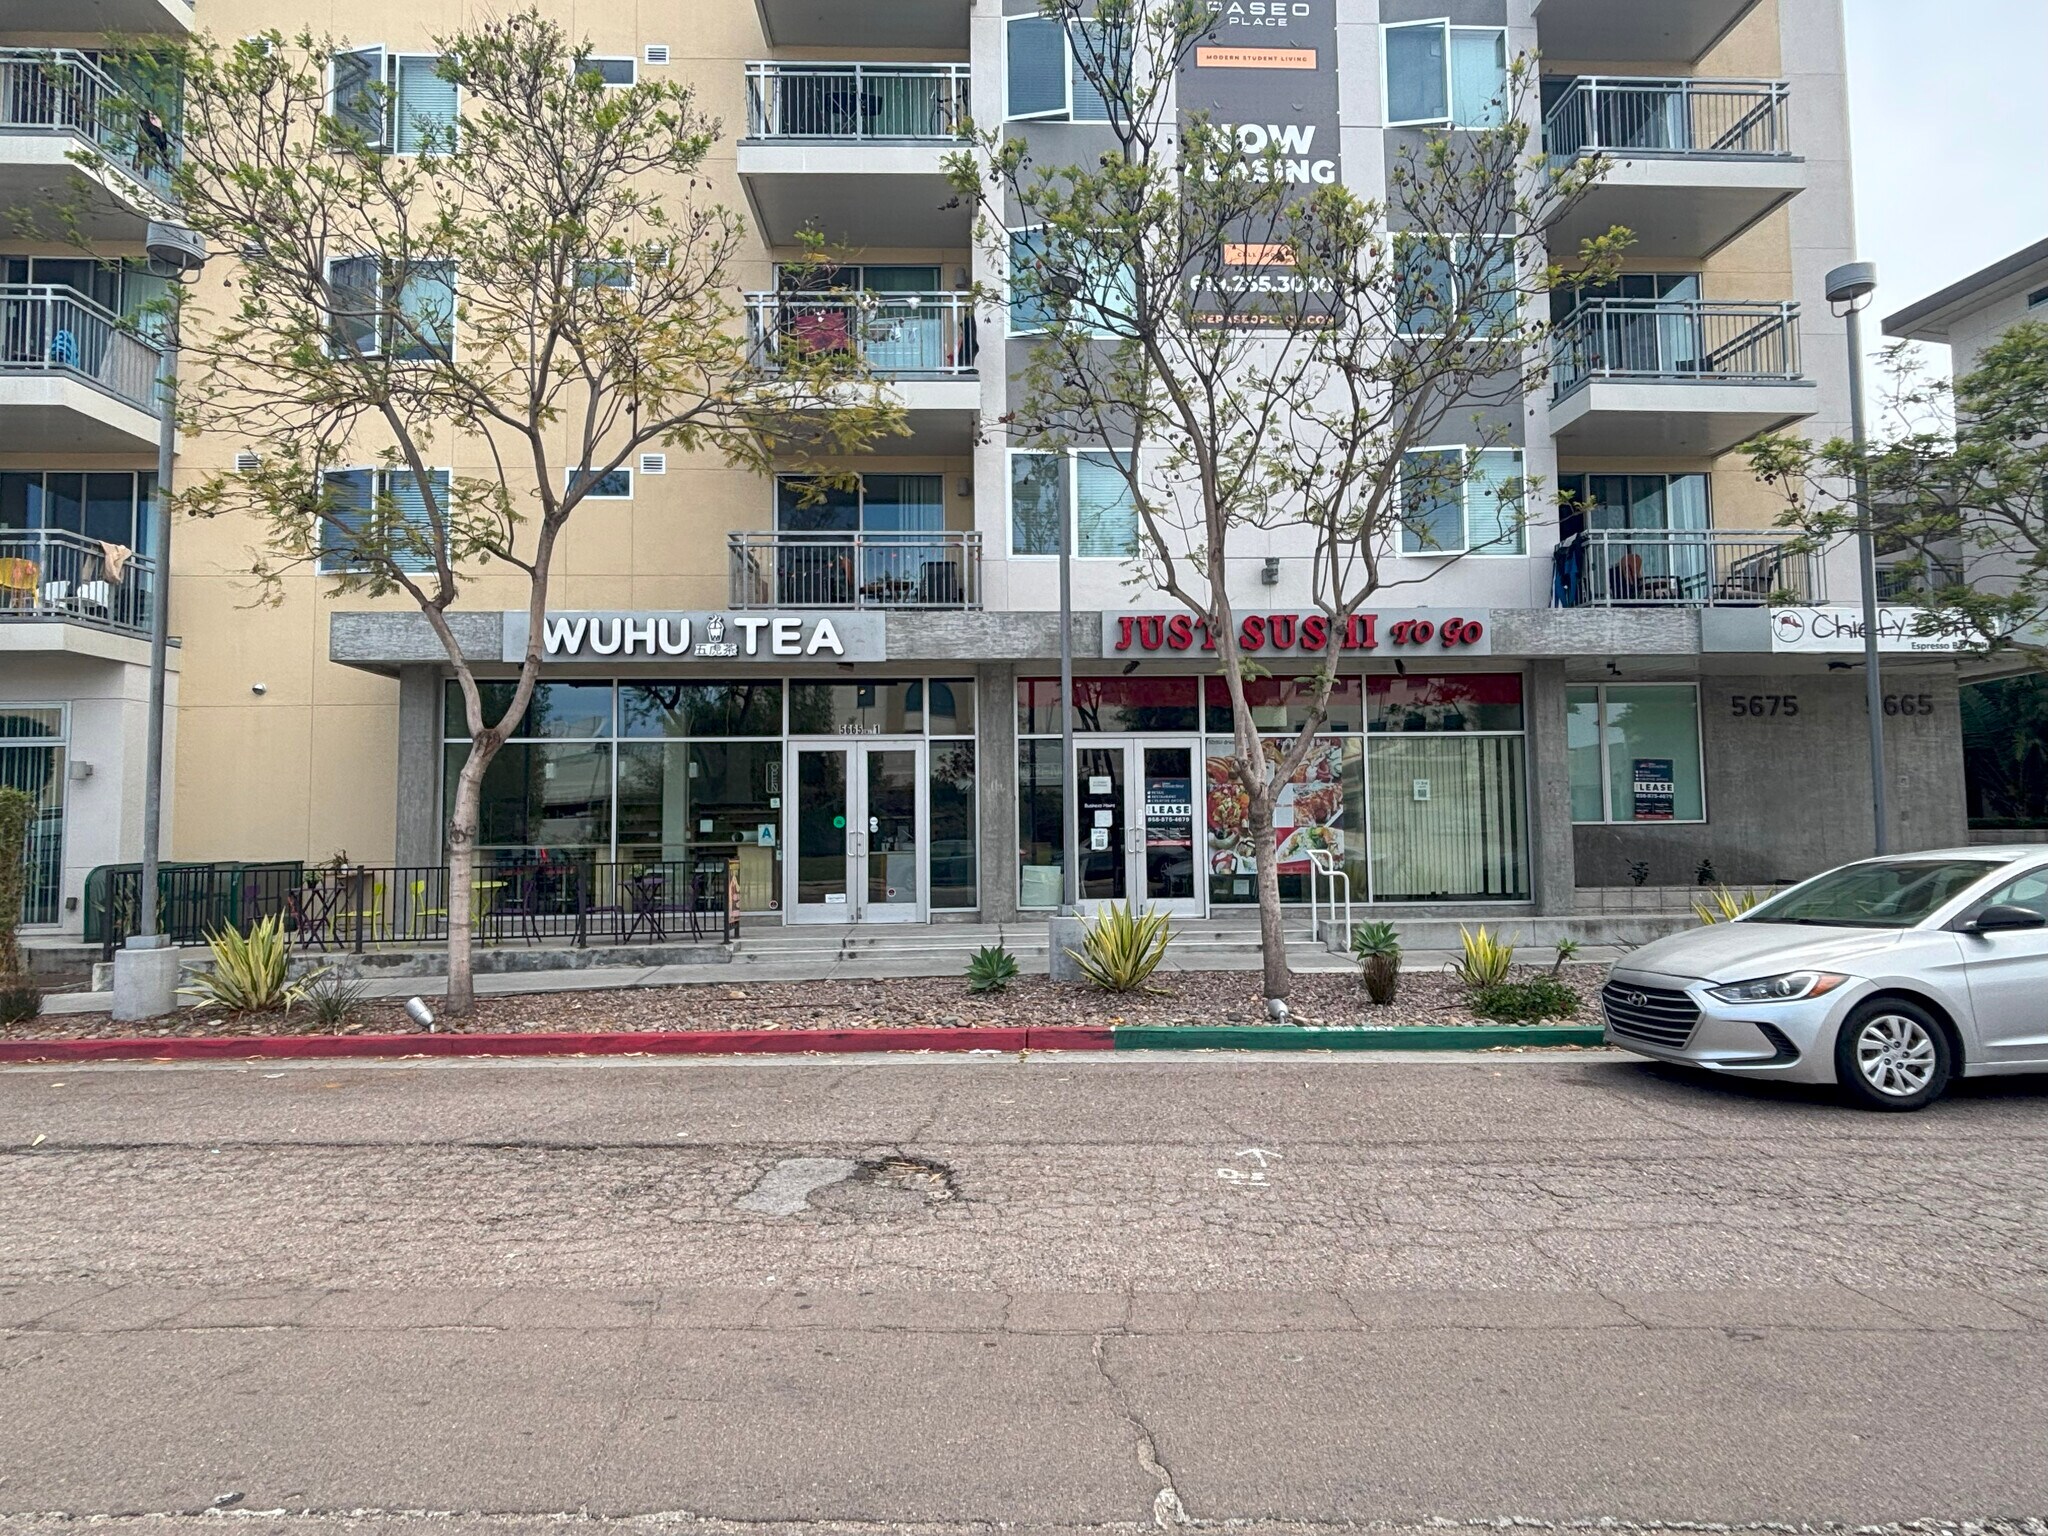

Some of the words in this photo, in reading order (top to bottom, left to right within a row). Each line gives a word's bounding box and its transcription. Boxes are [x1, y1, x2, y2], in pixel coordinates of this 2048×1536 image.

[1207, 1, 1310, 16] PASEO
[1229, 17, 1288, 27] PLACE
[543, 617, 691, 655] WUHU
[734, 617, 845, 655] TEA
[1390, 619, 1434, 645] TO
[1440, 617, 1483, 648] GO
[1911, 641, 1950, 651] Espresso
[1732, 695, 1799, 717] 5675
[1866, 694, 1934, 716] 665
[839, 725, 863, 735] 5665
[1639, 783, 1673, 791] LEASE
[1152, 805, 1190, 814] LEASE
[762, 827, 772, 838] A
